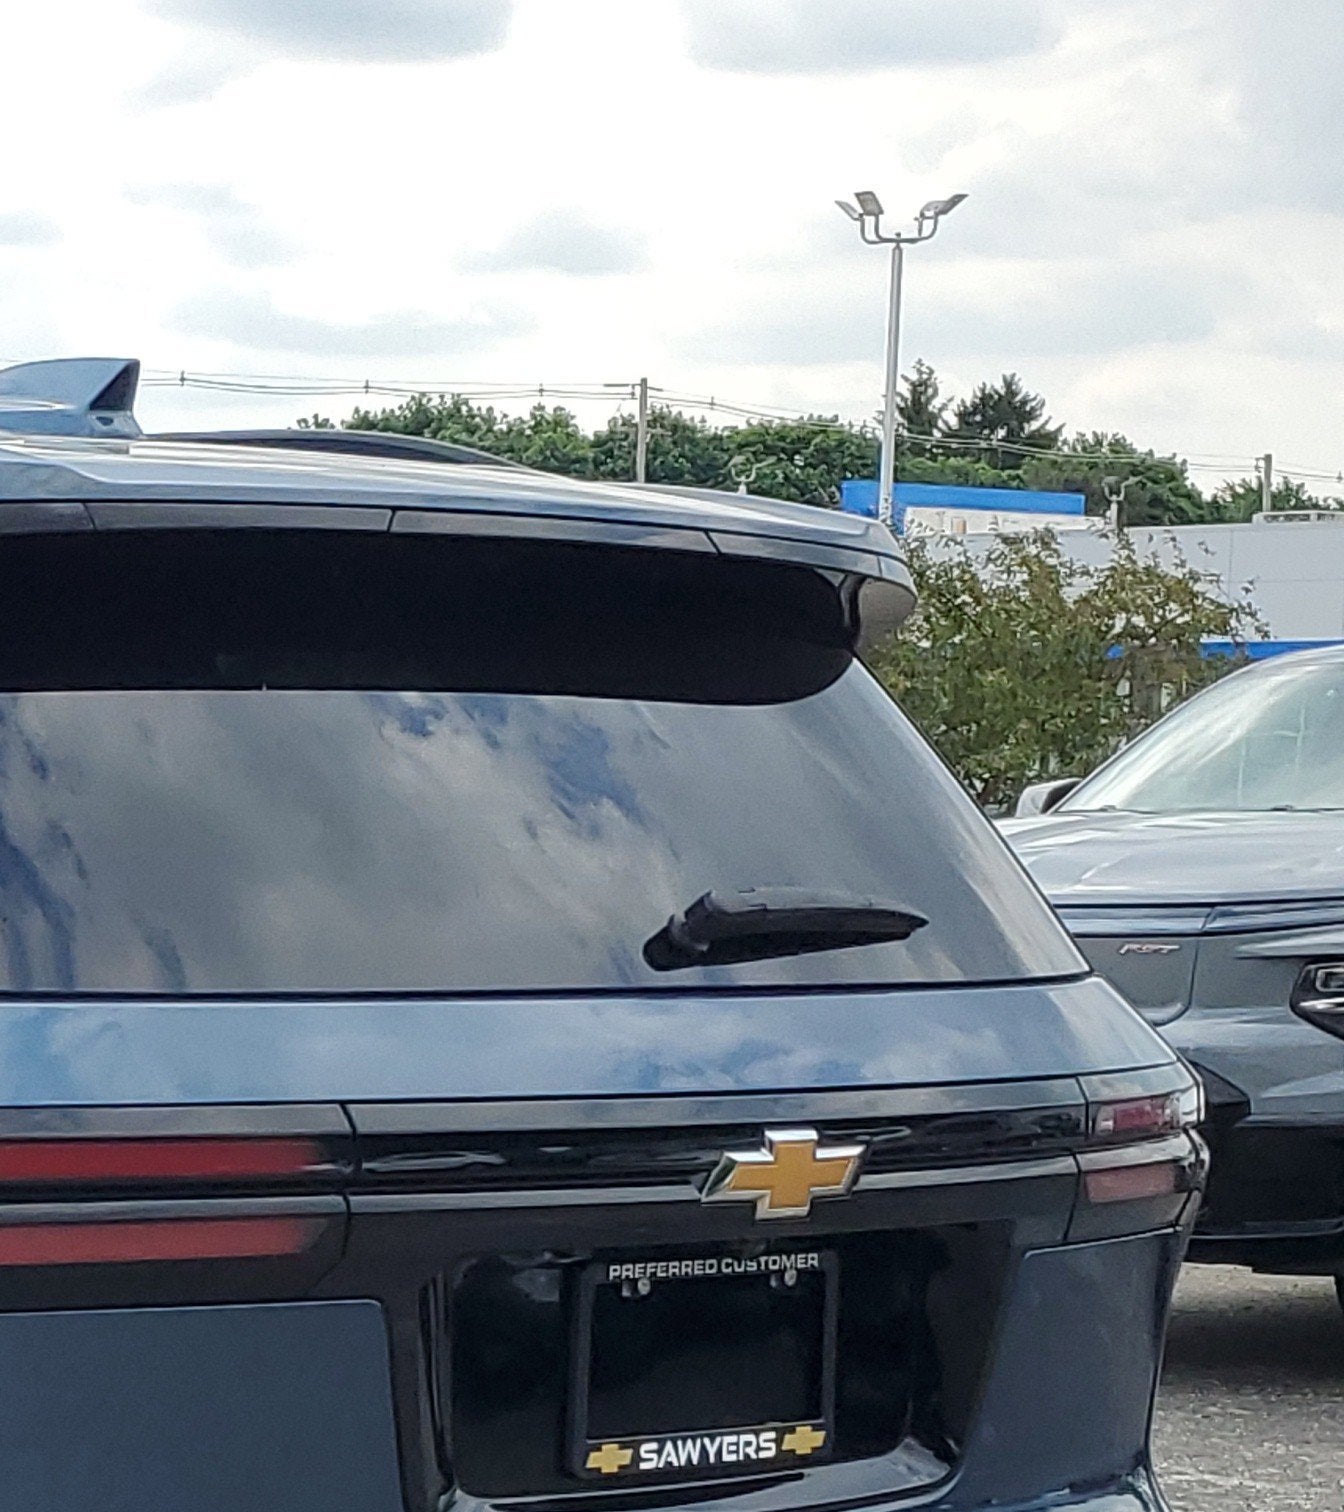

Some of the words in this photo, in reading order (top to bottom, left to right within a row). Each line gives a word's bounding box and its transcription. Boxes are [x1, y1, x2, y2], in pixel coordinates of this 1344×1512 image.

[609, 1259, 717, 1281] PREFERRED
[721, 1253, 819, 1273] CUSTOMER
[638, 1431, 776, 1470] SAWYERS
